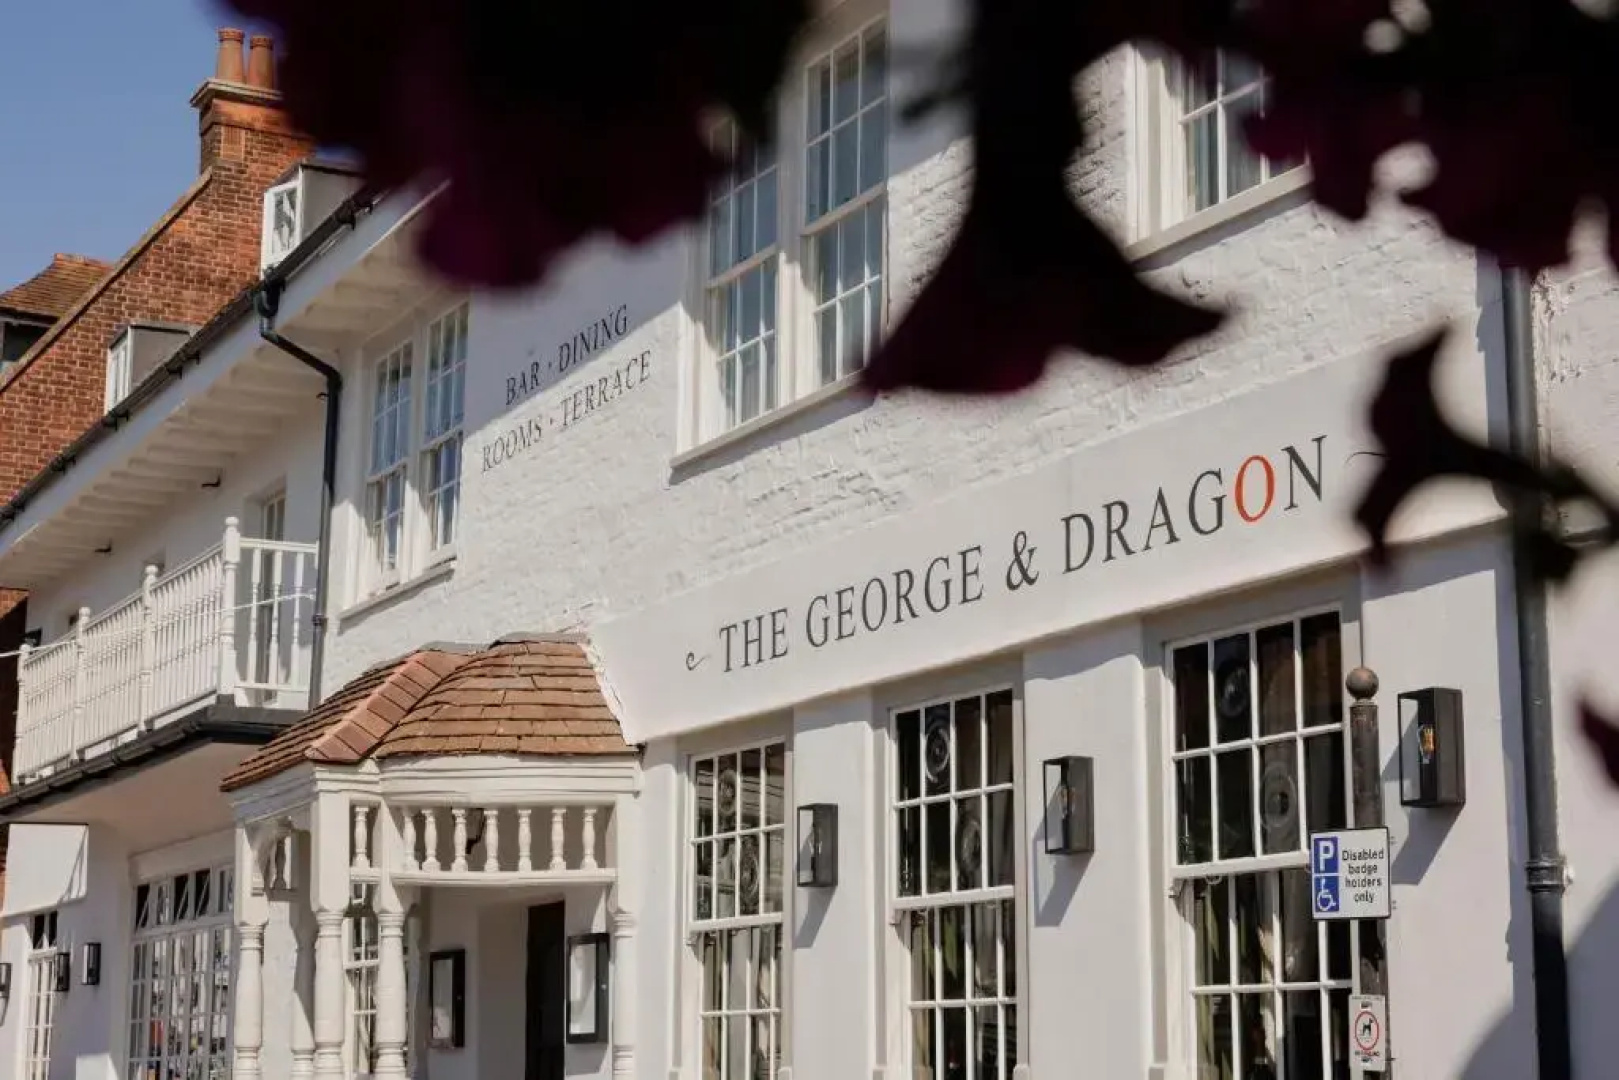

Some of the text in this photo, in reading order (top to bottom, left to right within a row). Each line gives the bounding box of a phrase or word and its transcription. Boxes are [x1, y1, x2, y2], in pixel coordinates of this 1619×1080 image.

[505, 304, 628, 405] BAR DINING
[482, 350, 651, 472] ROOMS TERRACE
[719, 434, 1327, 673] THE GEORGE & DRAGON
[1319, 840, 1335, 871] P
[1341, 848, 1384, 861] Disabled
[1348, 864, 1378, 875] badge
[1345, 877, 1382, 888] holders
[1354, 891, 1375, 903] only
